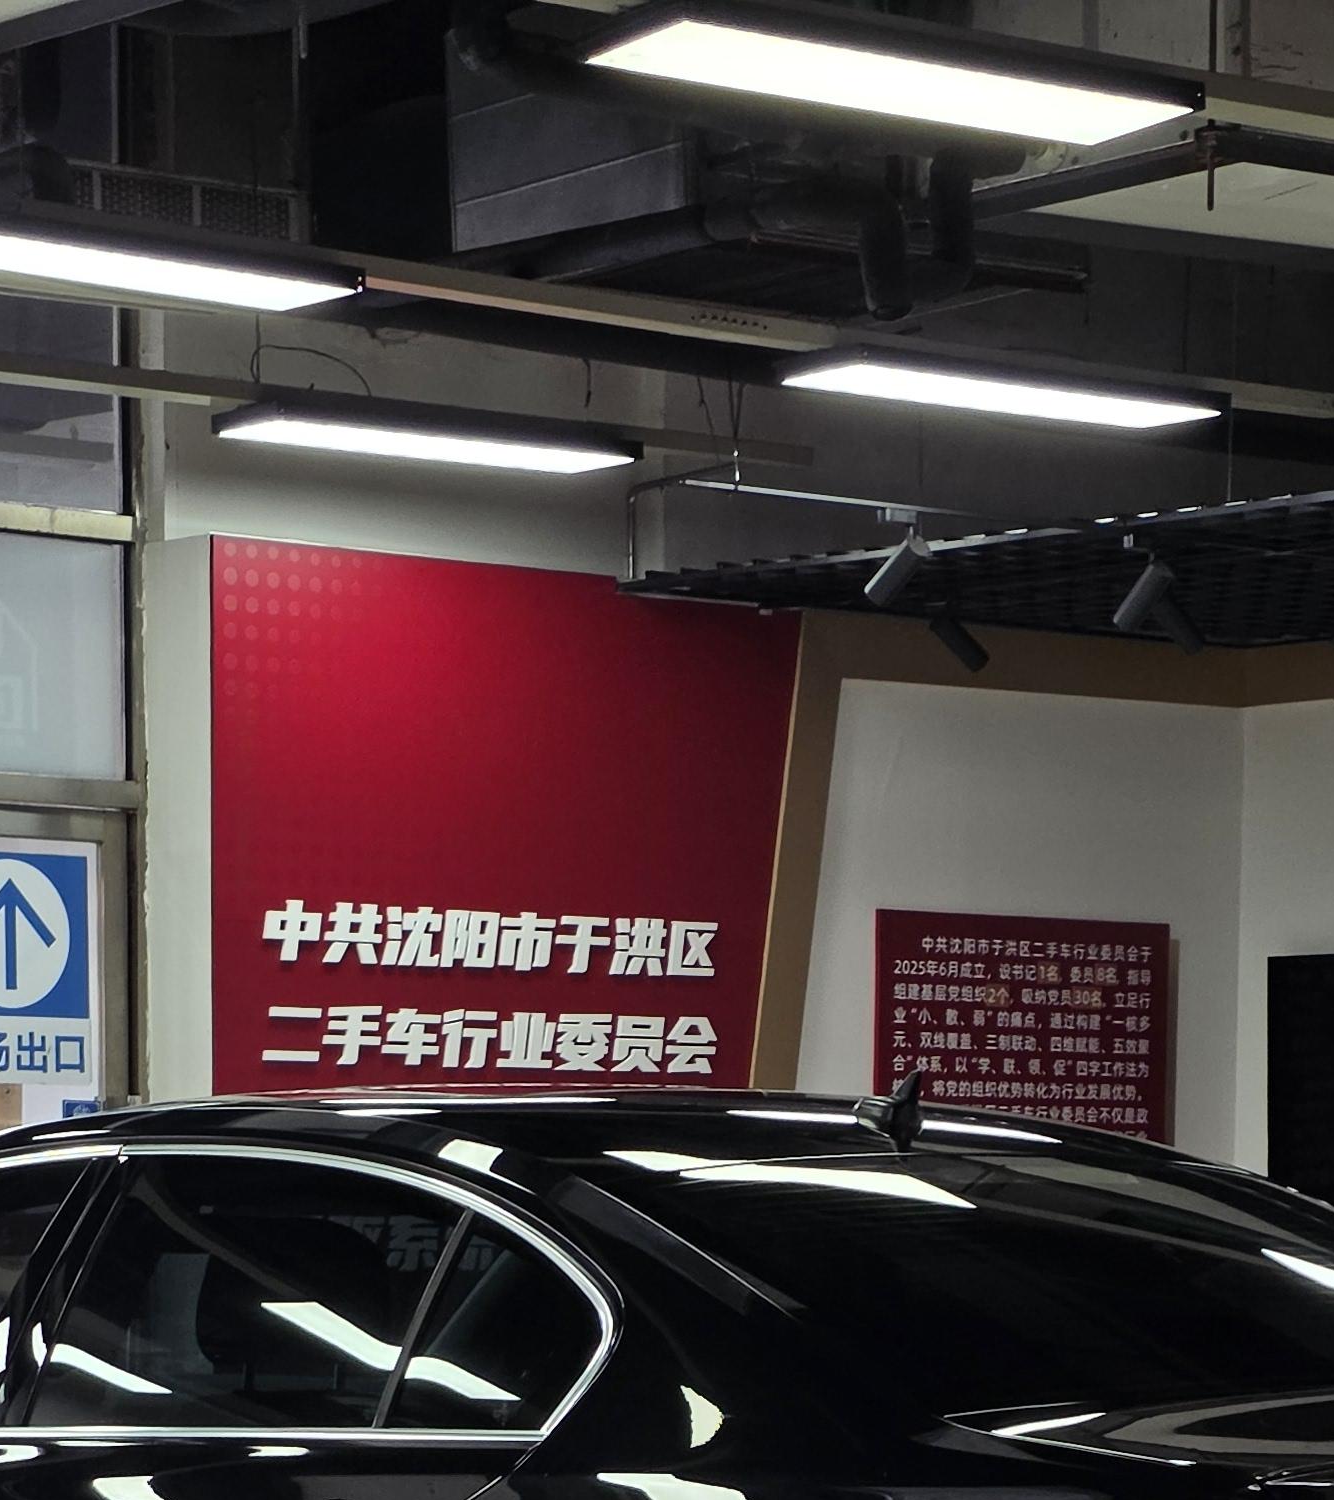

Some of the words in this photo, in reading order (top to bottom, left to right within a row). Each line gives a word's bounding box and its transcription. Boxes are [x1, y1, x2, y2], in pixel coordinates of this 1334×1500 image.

[262, 899, 719, 977] 中共沈阳市于洪区
[921, 934, 1153, 964] 中共沈阳市于洪区二手车行业委员会于
[262, 1005, 719, 1074] 二手车行业委员会
